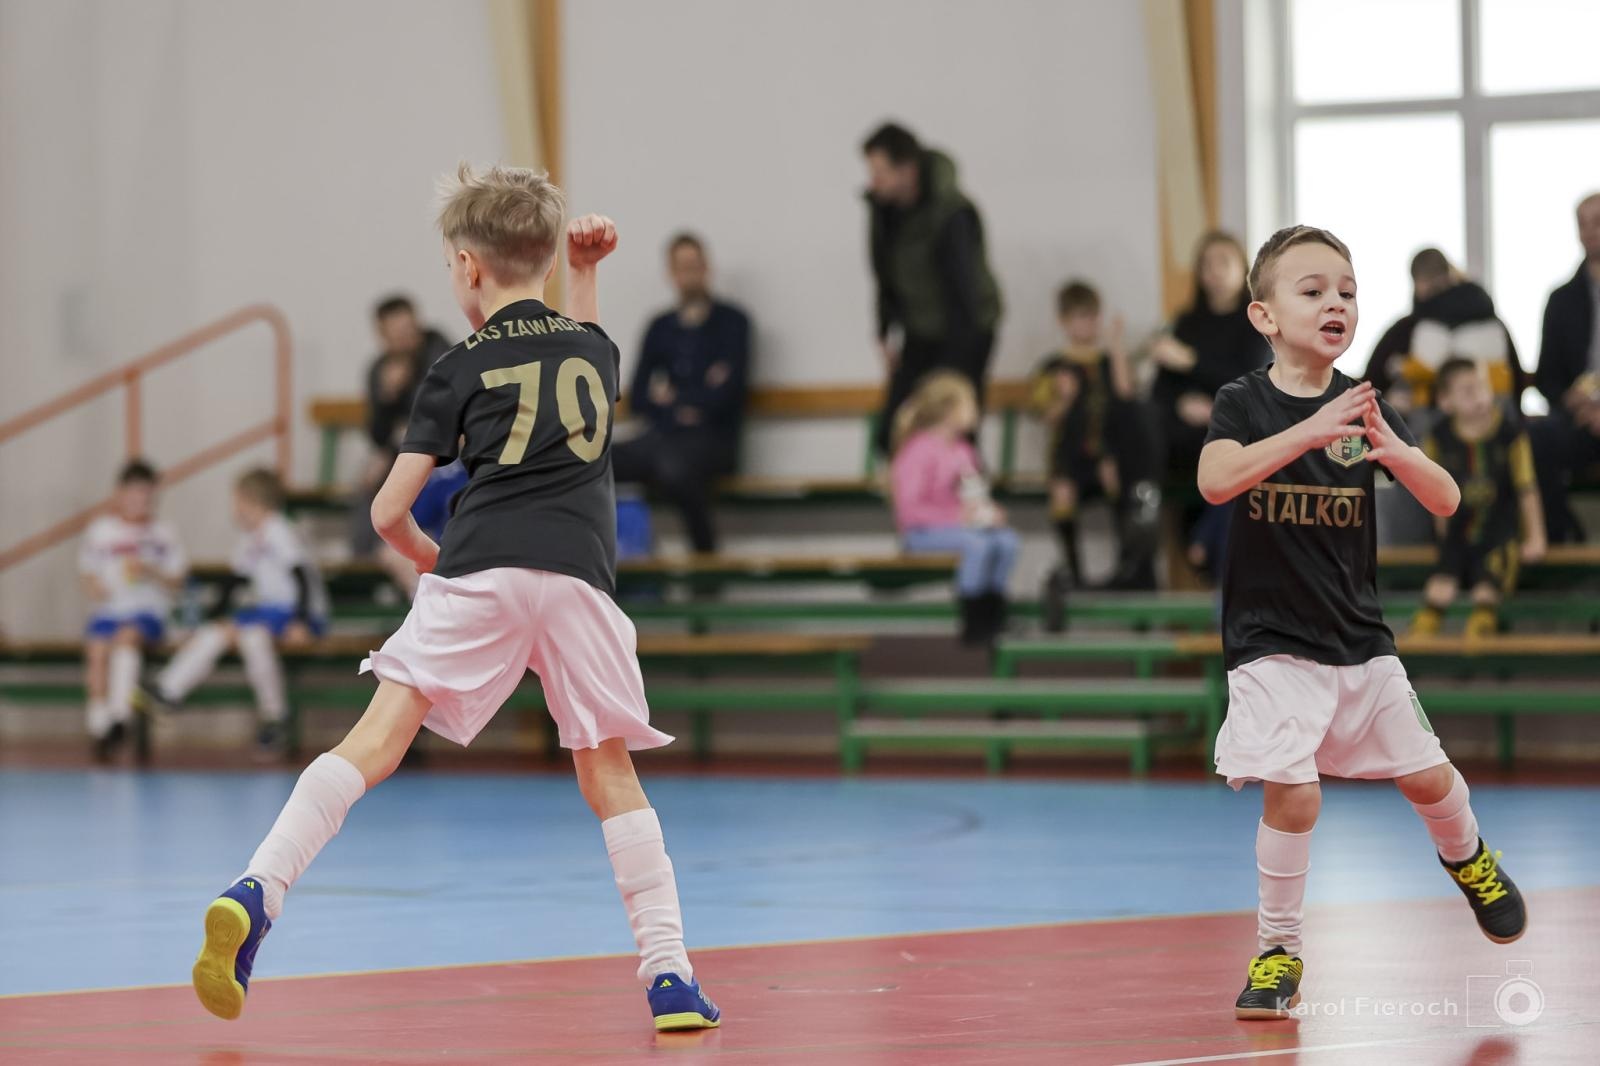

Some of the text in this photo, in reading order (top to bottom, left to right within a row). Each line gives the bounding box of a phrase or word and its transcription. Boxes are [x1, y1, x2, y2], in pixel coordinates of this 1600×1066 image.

[502, 315, 588, 338] ZAWADA
[480, 357, 609, 464] 70
[1249, 482, 1367, 528] STALKOL
